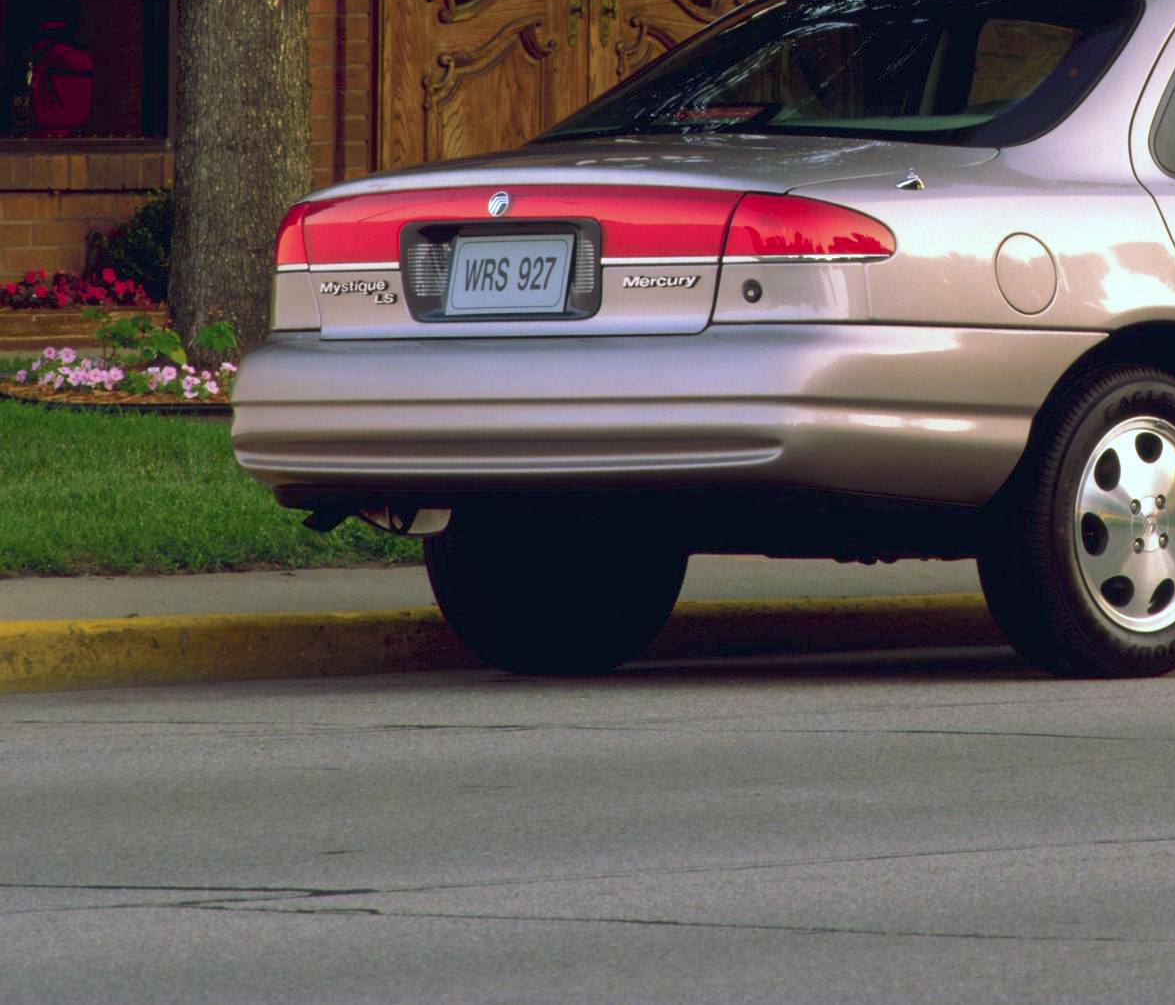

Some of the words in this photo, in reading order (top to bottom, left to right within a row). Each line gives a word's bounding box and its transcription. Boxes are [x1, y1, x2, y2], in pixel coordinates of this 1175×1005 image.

[464, 257, 510, 292] WRS
[517, 256, 557, 291] 927
[319, 281, 388, 295] Mystique
[622, 275, 701, 289] Mercury
[374, 293, 397, 305] LS
